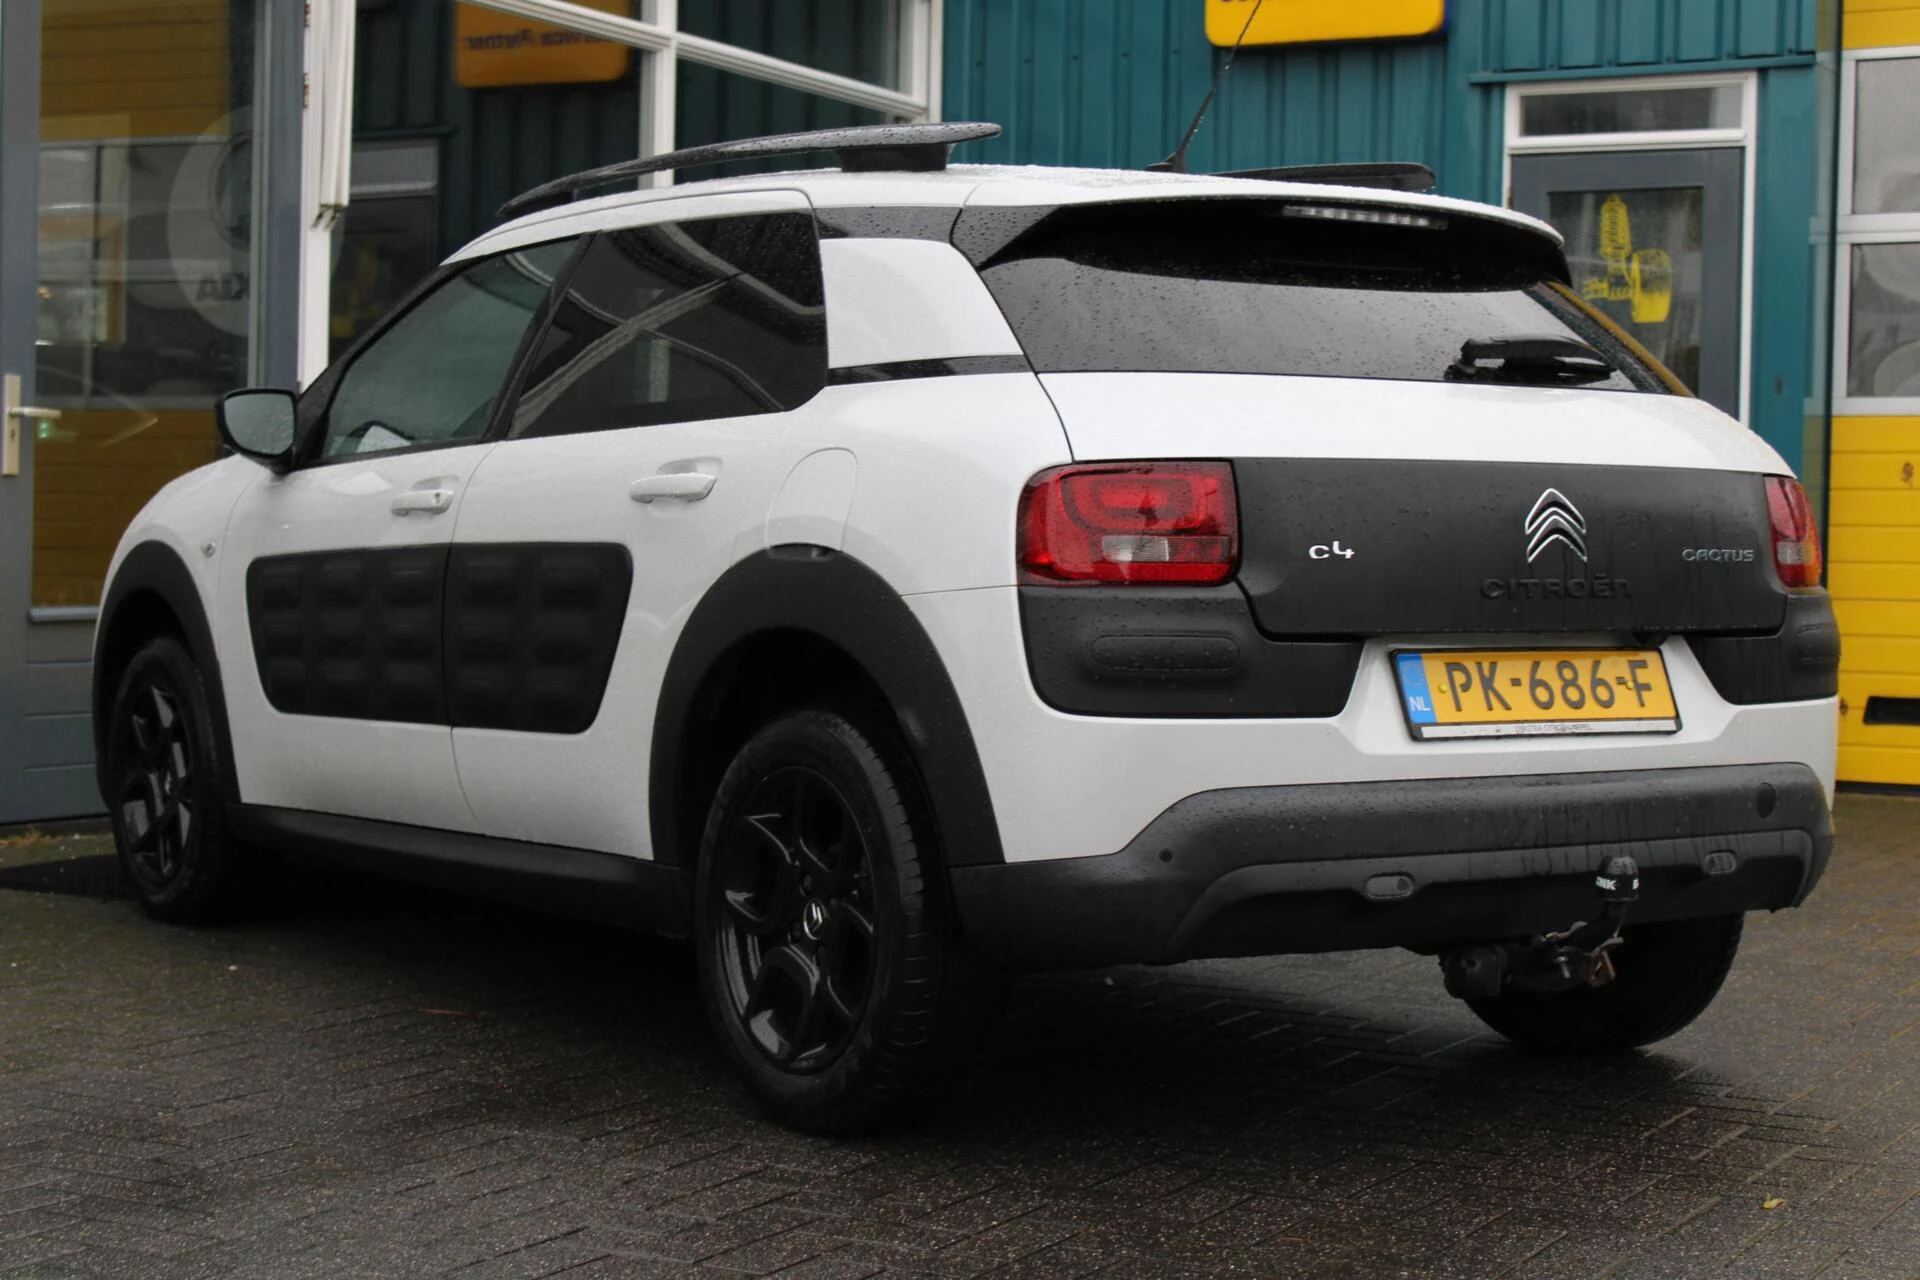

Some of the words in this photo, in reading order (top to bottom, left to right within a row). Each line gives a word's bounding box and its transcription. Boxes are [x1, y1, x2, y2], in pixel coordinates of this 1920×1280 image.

[1308, 540, 1356, 559] C4
[1681, 548, 1754, 562] CACTUS
[1444, 659, 1653, 713] PK-686-F
[1408, 695, 1432, 712] NL
